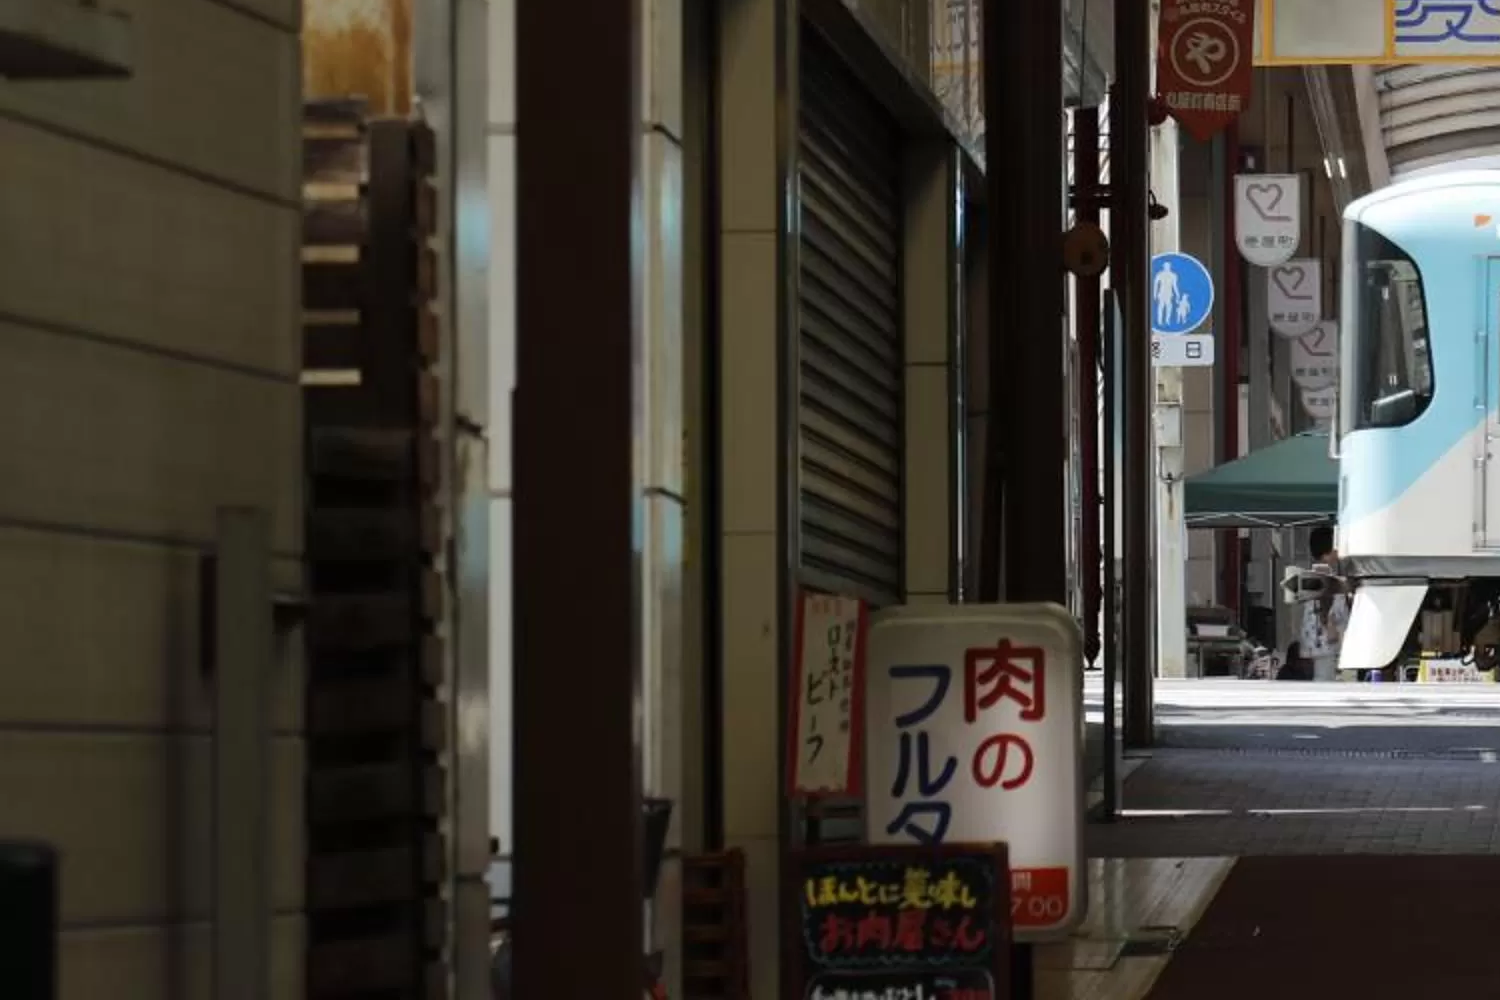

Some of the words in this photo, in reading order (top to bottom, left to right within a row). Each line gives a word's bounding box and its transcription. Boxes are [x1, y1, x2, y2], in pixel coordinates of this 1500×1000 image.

[886, 664, 958, 847] フルタ
[963, 637, 1045, 790] 肉の
[818, 908, 988, 952] お肉屋さん
